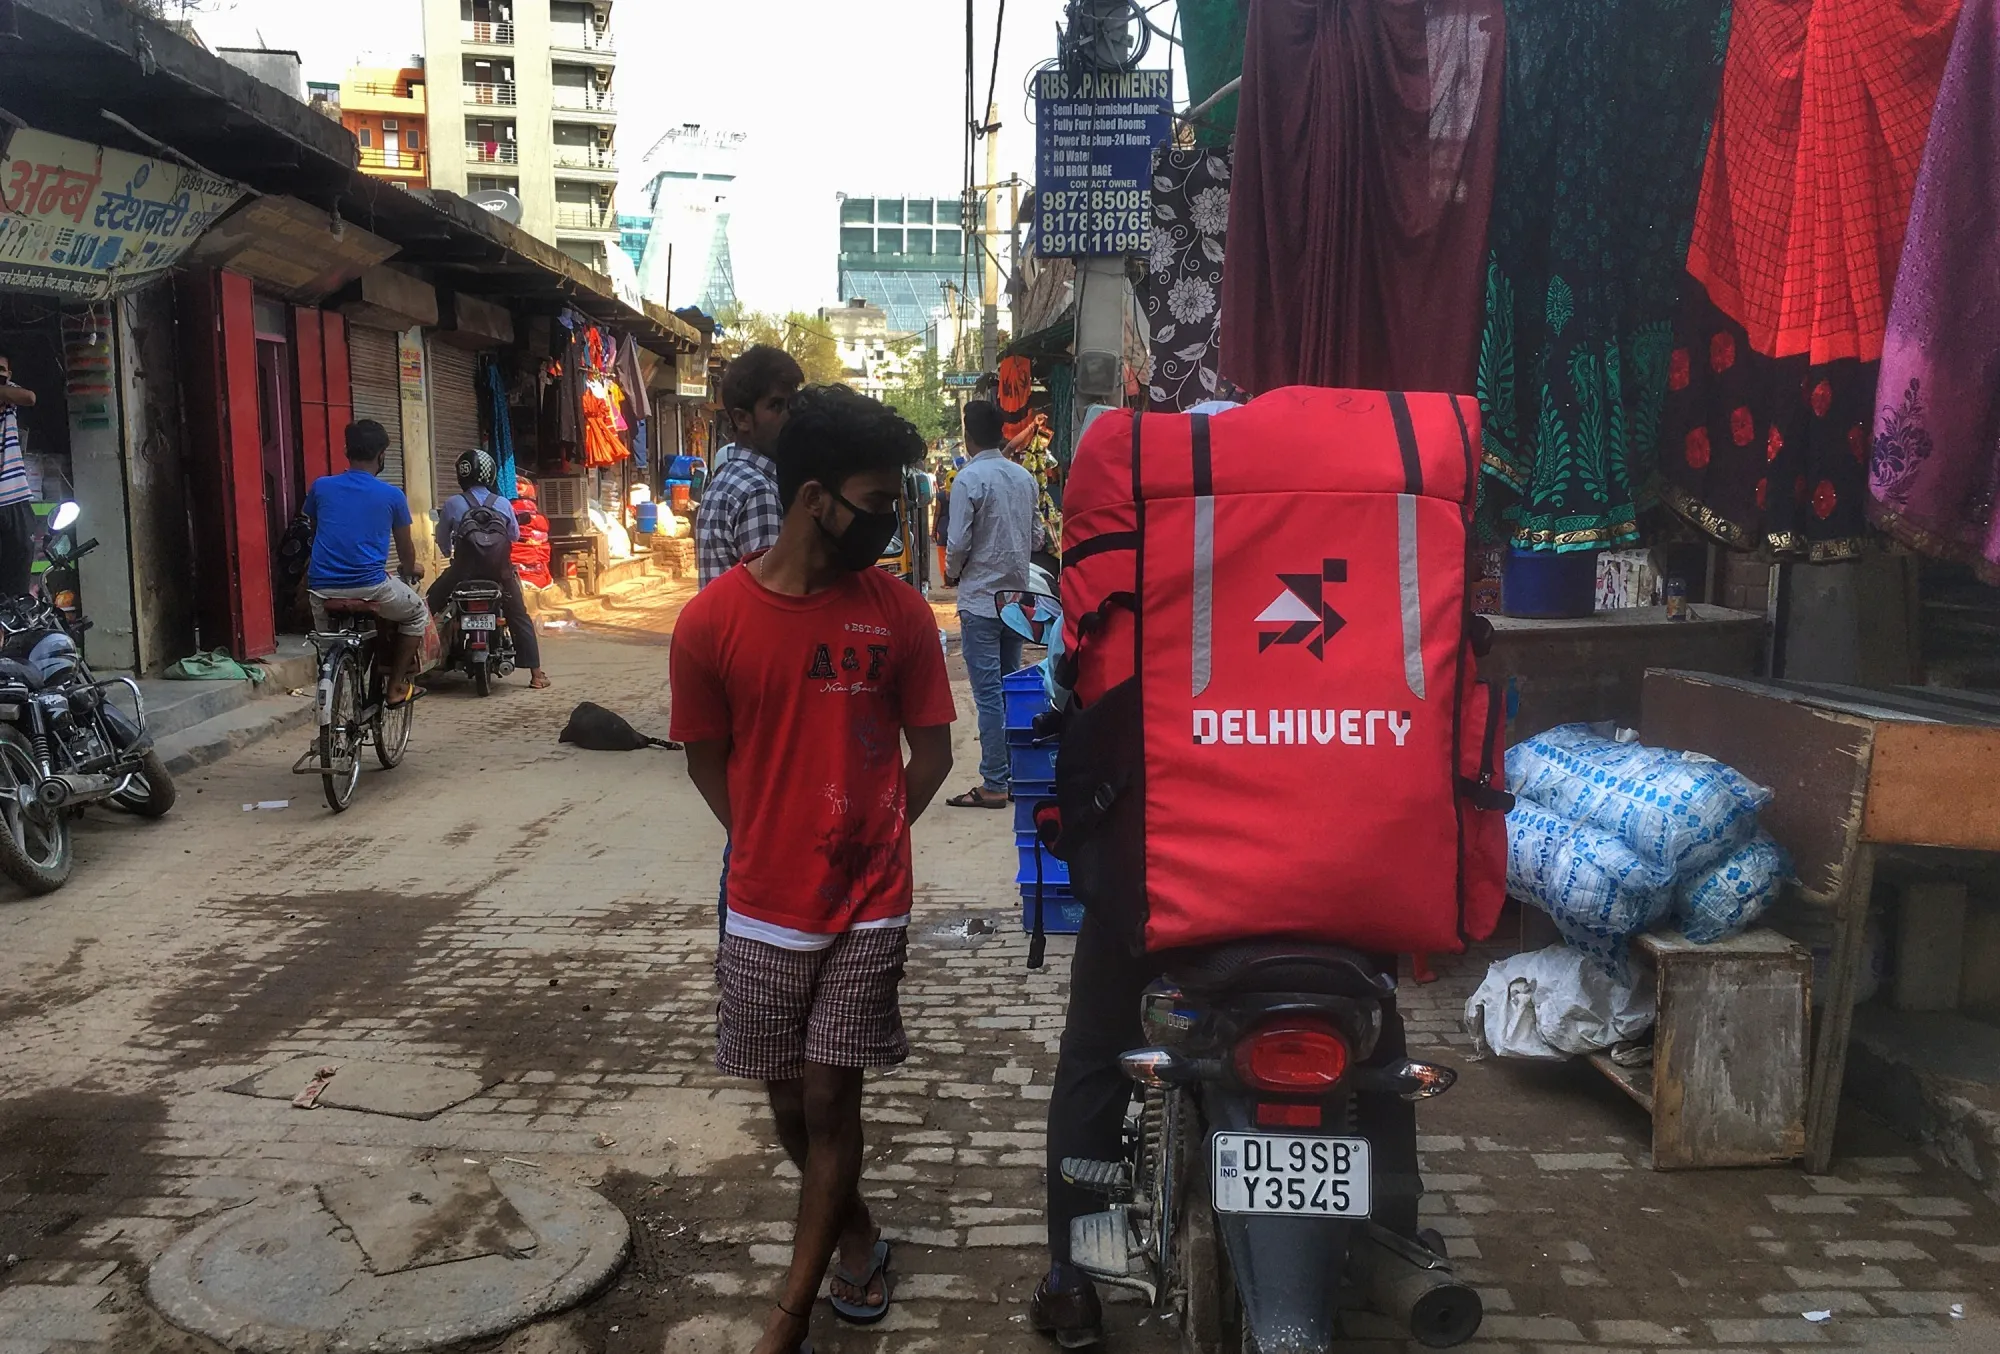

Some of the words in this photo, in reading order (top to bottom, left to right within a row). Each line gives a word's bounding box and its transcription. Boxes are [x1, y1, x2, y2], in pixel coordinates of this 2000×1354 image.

[1040, 73, 1069, 99] RBS
[1053, 104, 1072, 116] Semi
[1074, 104, 1092, 116] Fully
[1054, 119, 1073, 131] Fully
[1118, 119, 1146, 130] Rooms
[1054, 135, 1079, 146] Power
[1126, 134, 1151, 146] Hours
[1053, 150, 1065, 162] RO
[1053, 165, 1065, 177] NO
[1066, 164, 1112, 177] BROKRAGE
[1070, 180, 1106, 188] CONACT
[1108, 179, 1137, 188] OWNER
[808, 644, 837, 679] A
[841, 647, 860, 671] &
[867, 645, 888, 680] F
[1193, 709, 1412, 746] DELHIVERY
[1243, 1139, 1351, 1175] DL9SB
[1220, 1168, 1238, 1178] IND
[1243, 1176, 1350, 1211] Y3545
